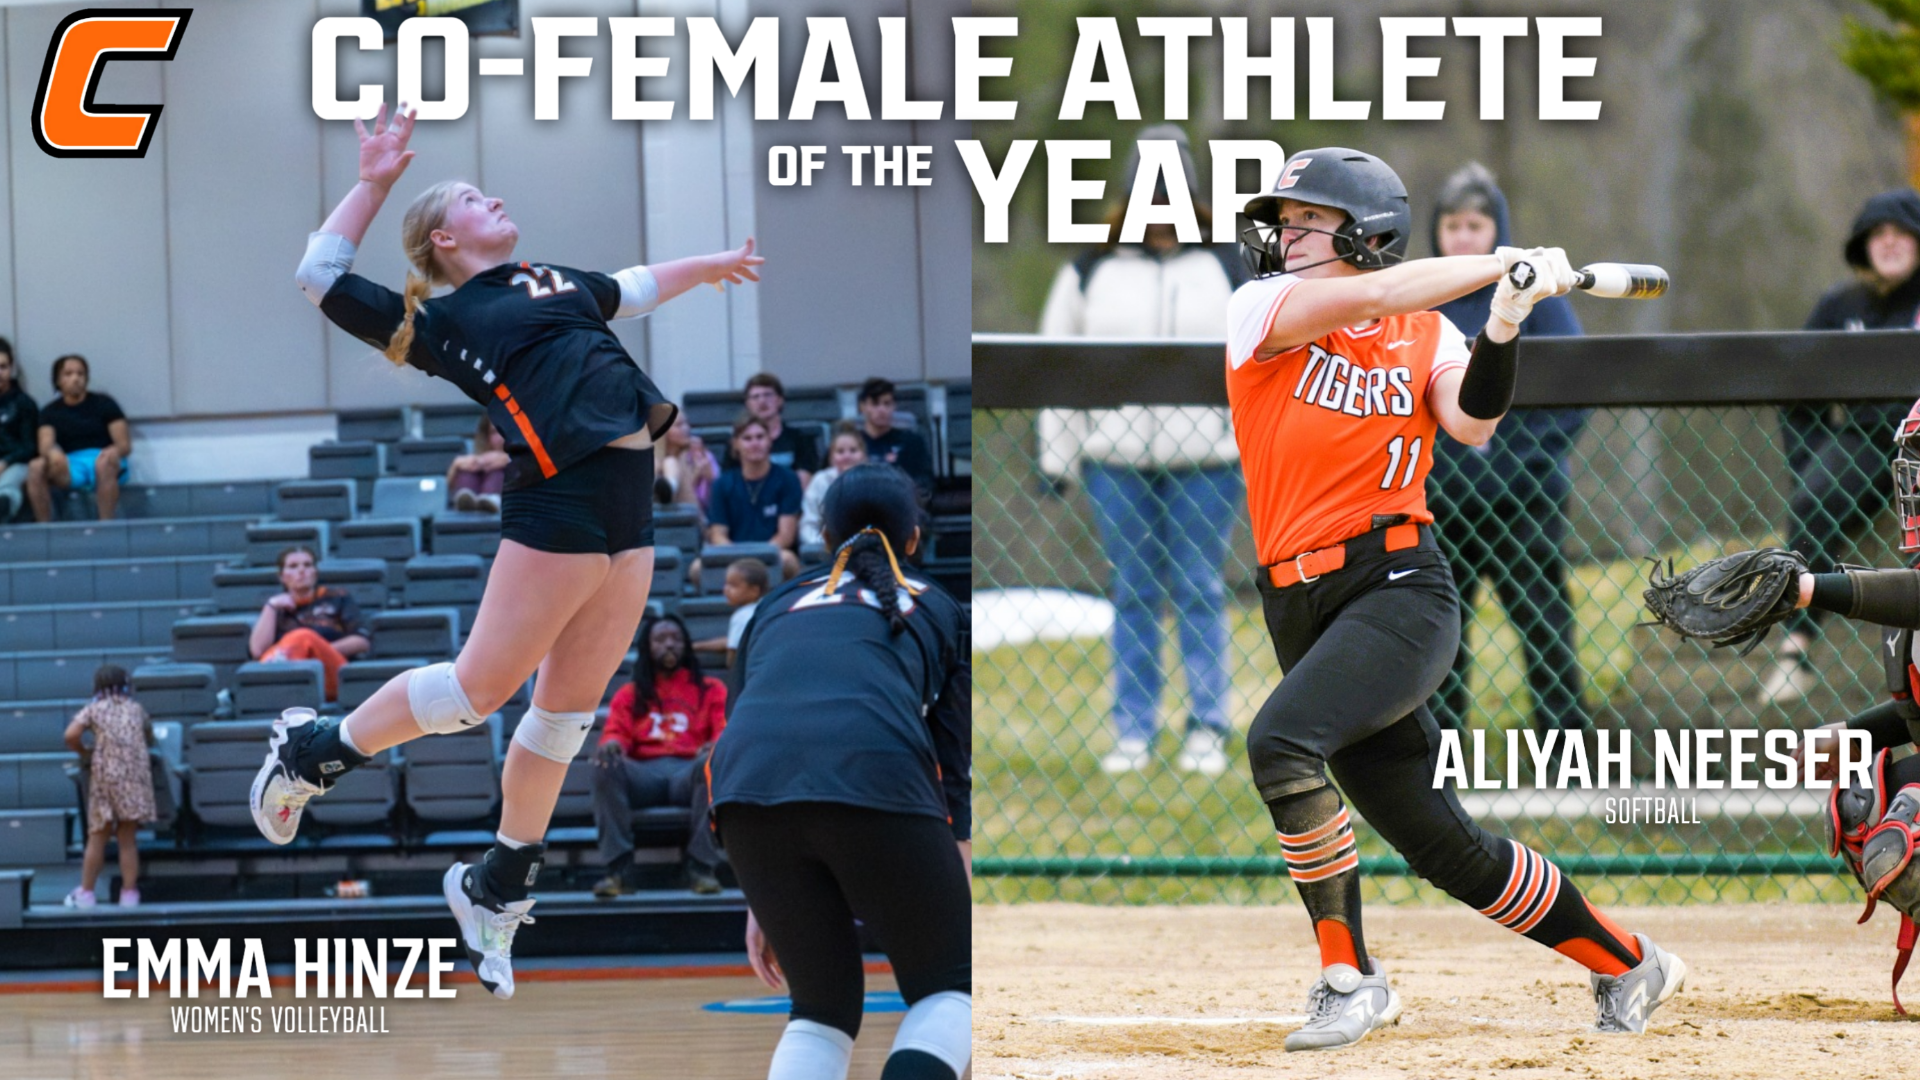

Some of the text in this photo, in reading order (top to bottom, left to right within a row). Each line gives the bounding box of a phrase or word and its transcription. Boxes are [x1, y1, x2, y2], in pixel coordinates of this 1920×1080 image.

[509, 266, 578, 299] 22
[1293, 342, 1415, 418] TIGERS
[1379, 435, 1423, 490] 11
